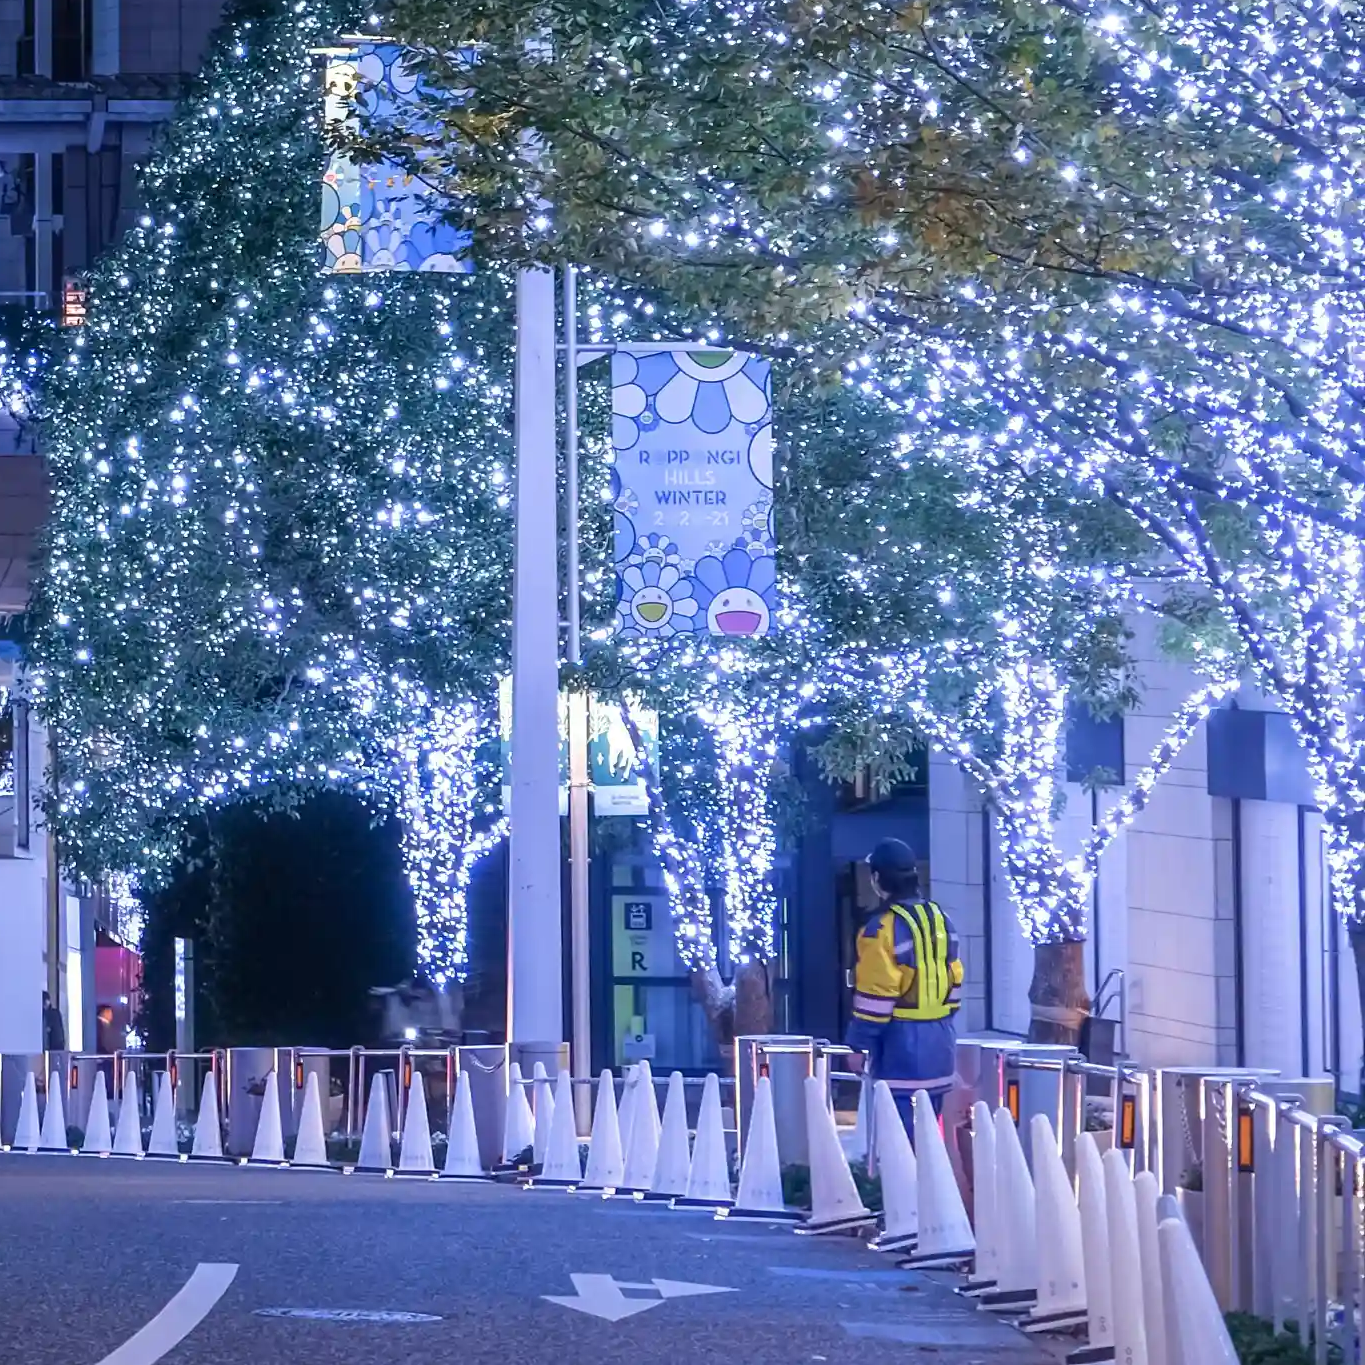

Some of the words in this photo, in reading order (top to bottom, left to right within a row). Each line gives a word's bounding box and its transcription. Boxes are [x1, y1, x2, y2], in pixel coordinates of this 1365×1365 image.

[639, 450, 741, 465] RPPNGI
[665, 469, 715, 485] HILLS
[654, 490, 726, 505] WINTER
[654, 510, 729, 526] 22-21
